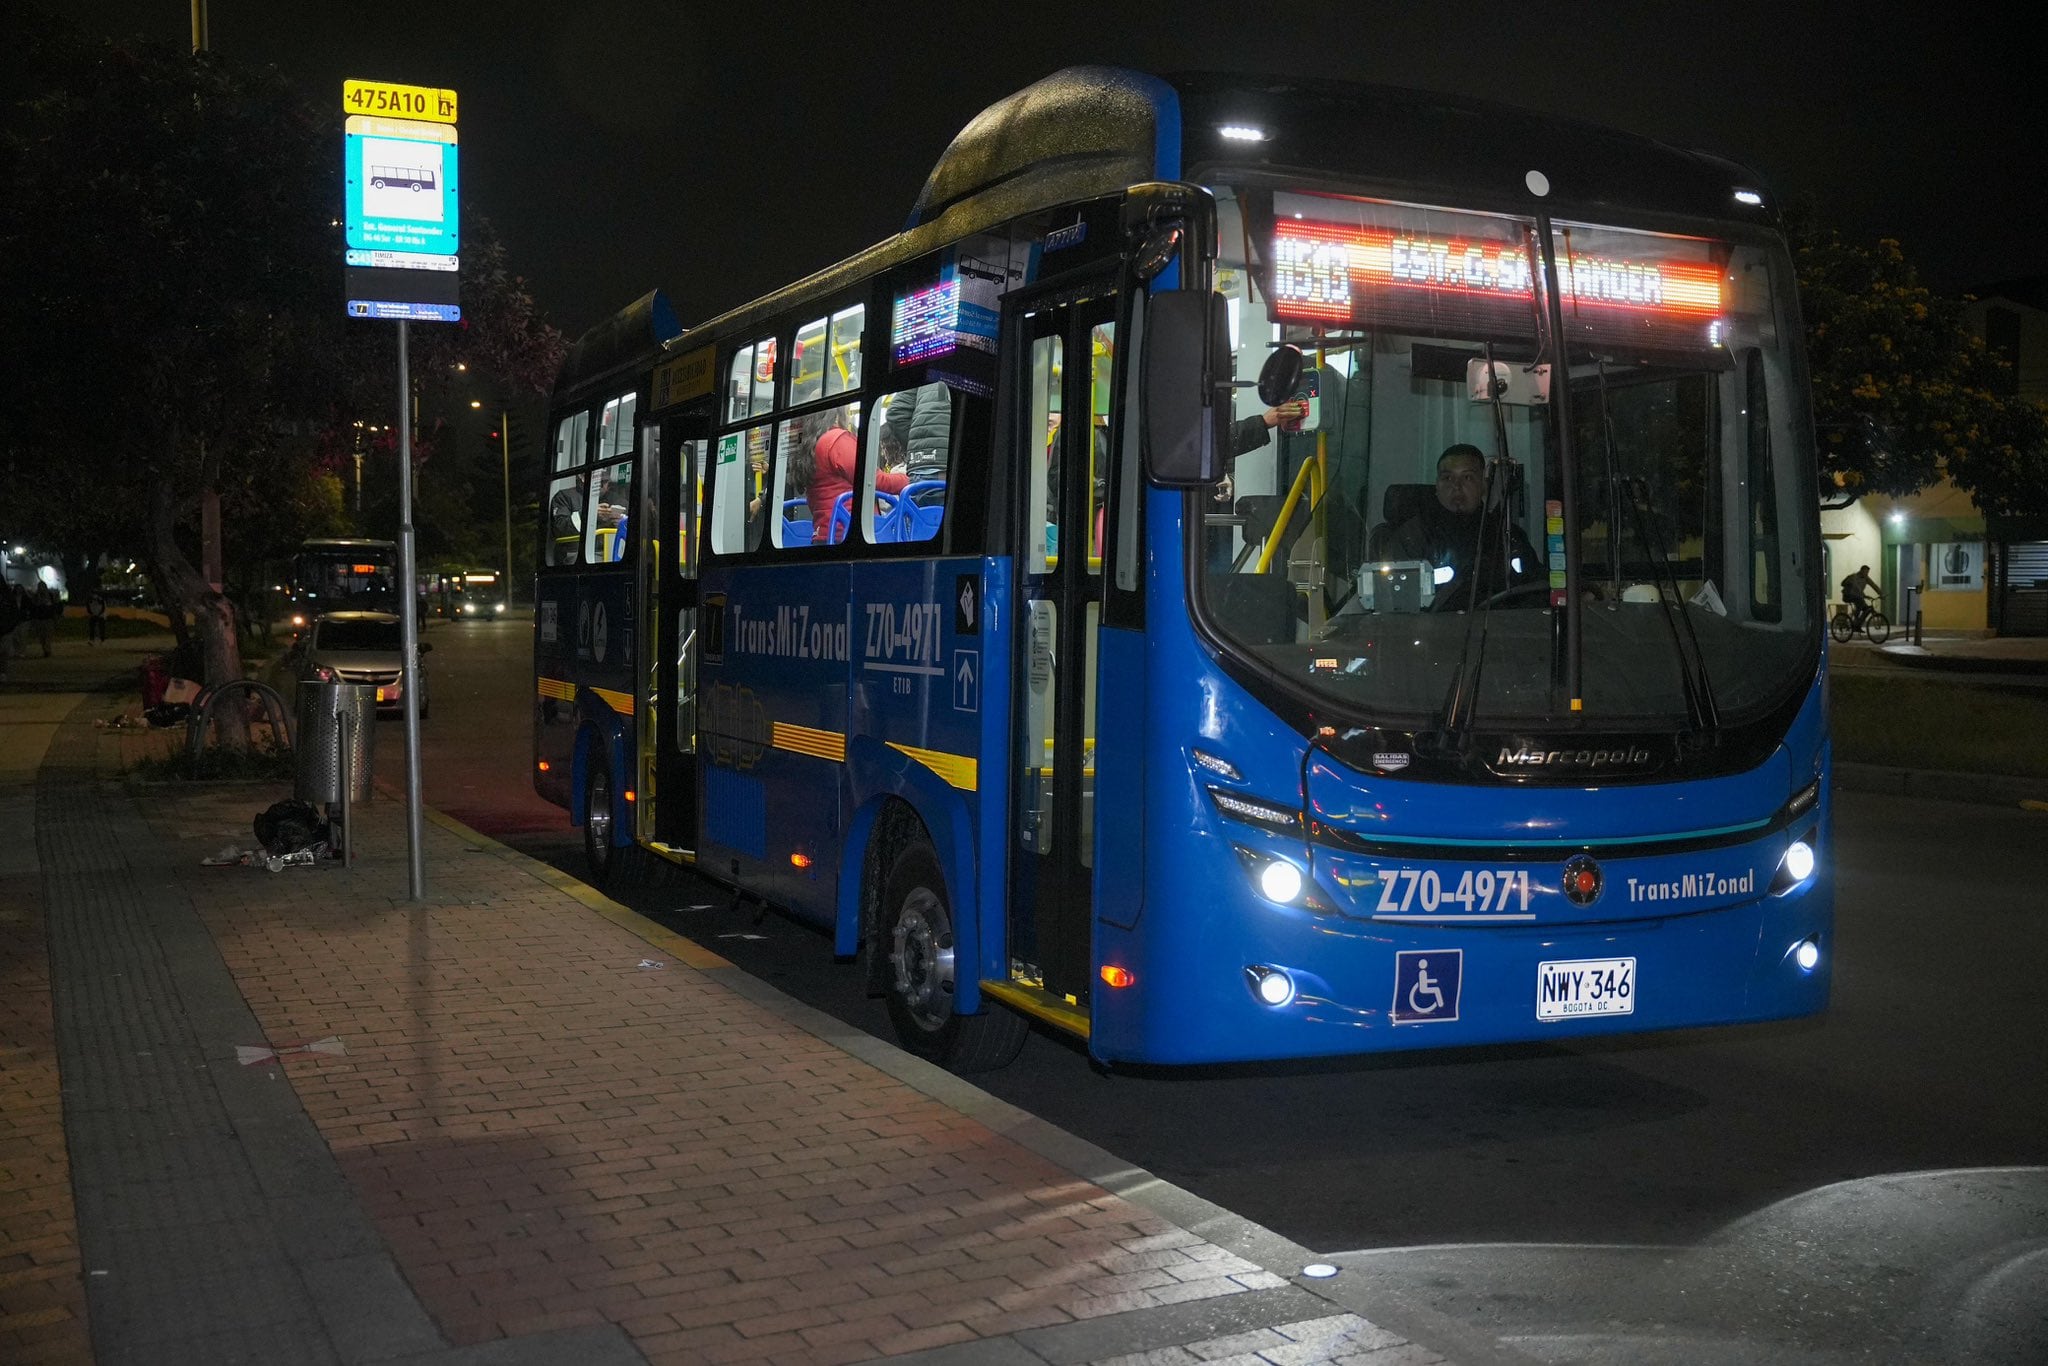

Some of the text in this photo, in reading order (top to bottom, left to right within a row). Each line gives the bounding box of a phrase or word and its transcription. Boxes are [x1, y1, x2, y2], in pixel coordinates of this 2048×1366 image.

[352, 88, 425, 113] 475A10
[733, 603, 851, 662] TransMiZonal
[865, 602, 942, 662] Z70-4971
[893, 676, 911, 694] ETIB
[1496, 746, 1648, 767] Marcopolo
[1376, 869, 1529, 912] Z70-4971
[1628, 868, 1754, 902] TransMiZonal
[1542, 969, 1631, 1003] NWY 346
[1563, 1002, 1593, 1013] BOGOTA
